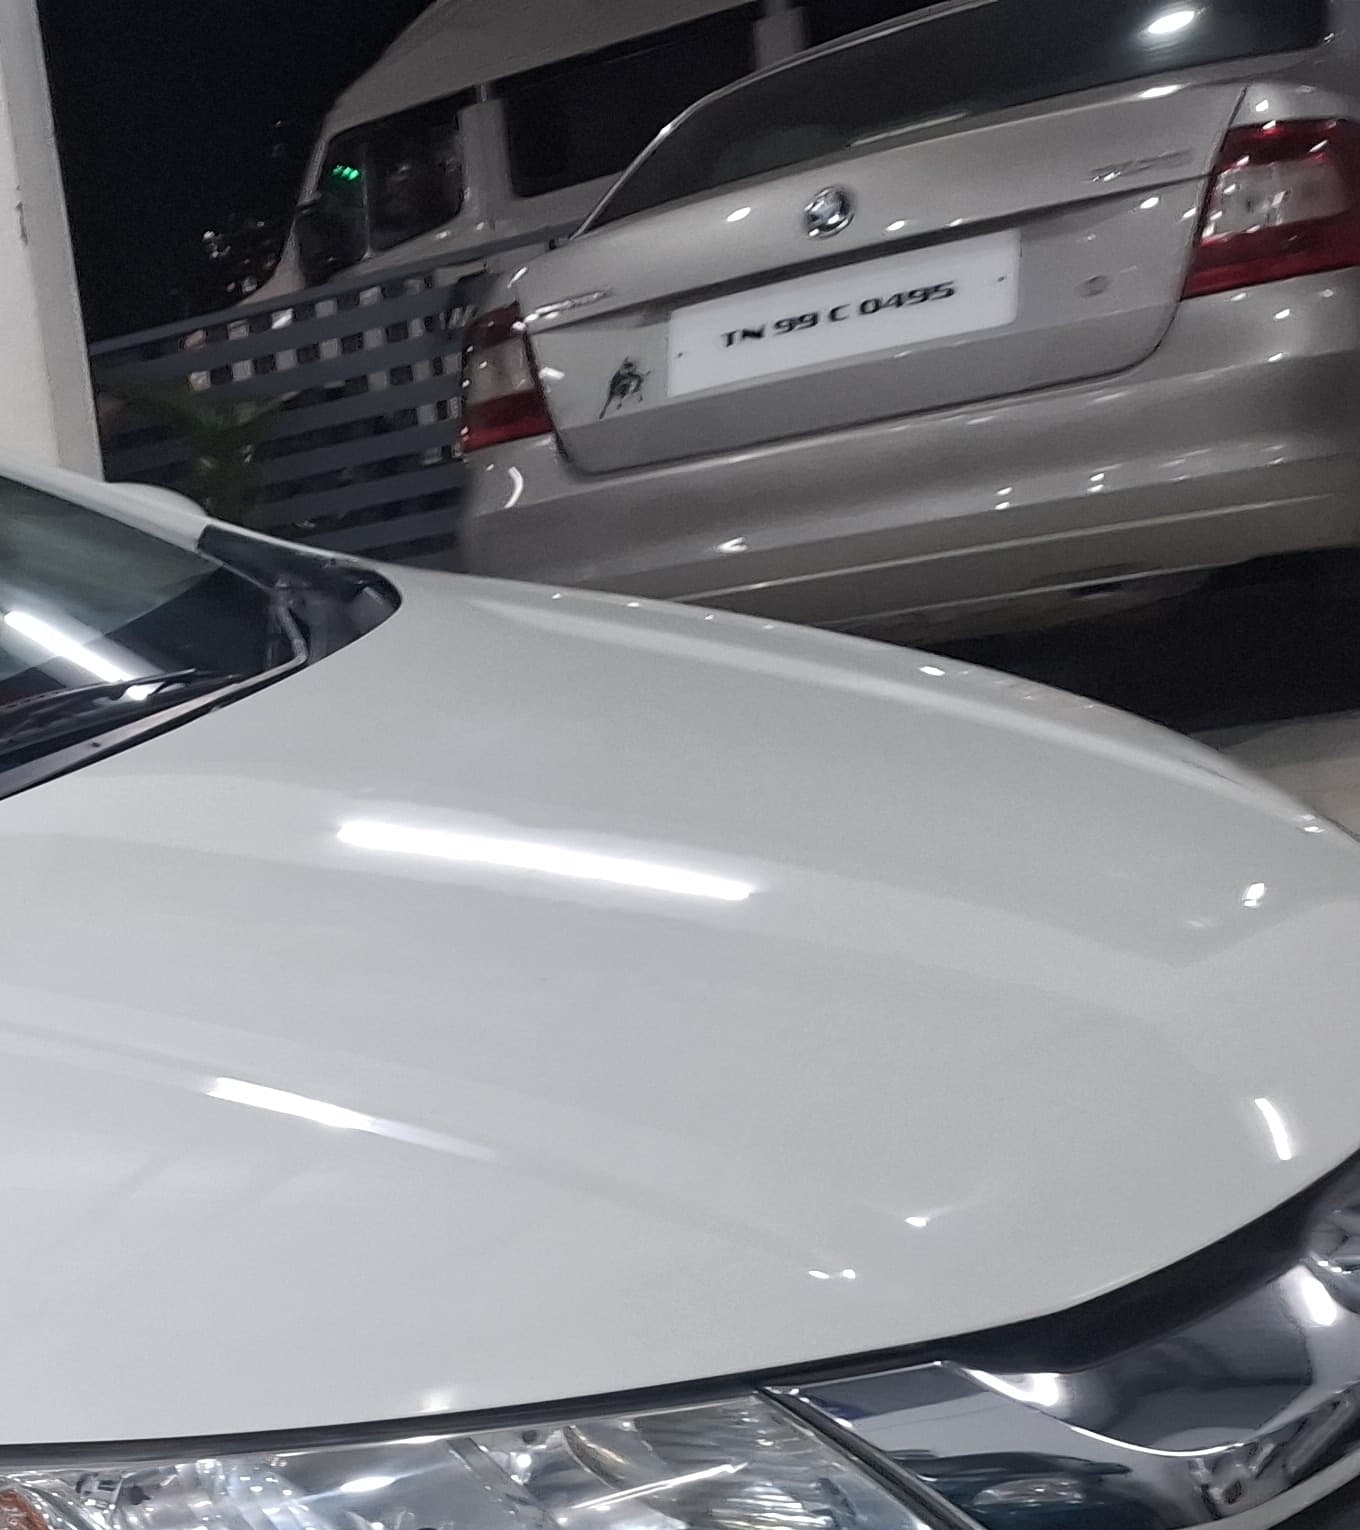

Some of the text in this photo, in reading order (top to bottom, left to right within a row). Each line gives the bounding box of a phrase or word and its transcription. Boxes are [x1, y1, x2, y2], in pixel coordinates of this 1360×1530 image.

[720, 280, 959, 348] TN 99 C 0495
